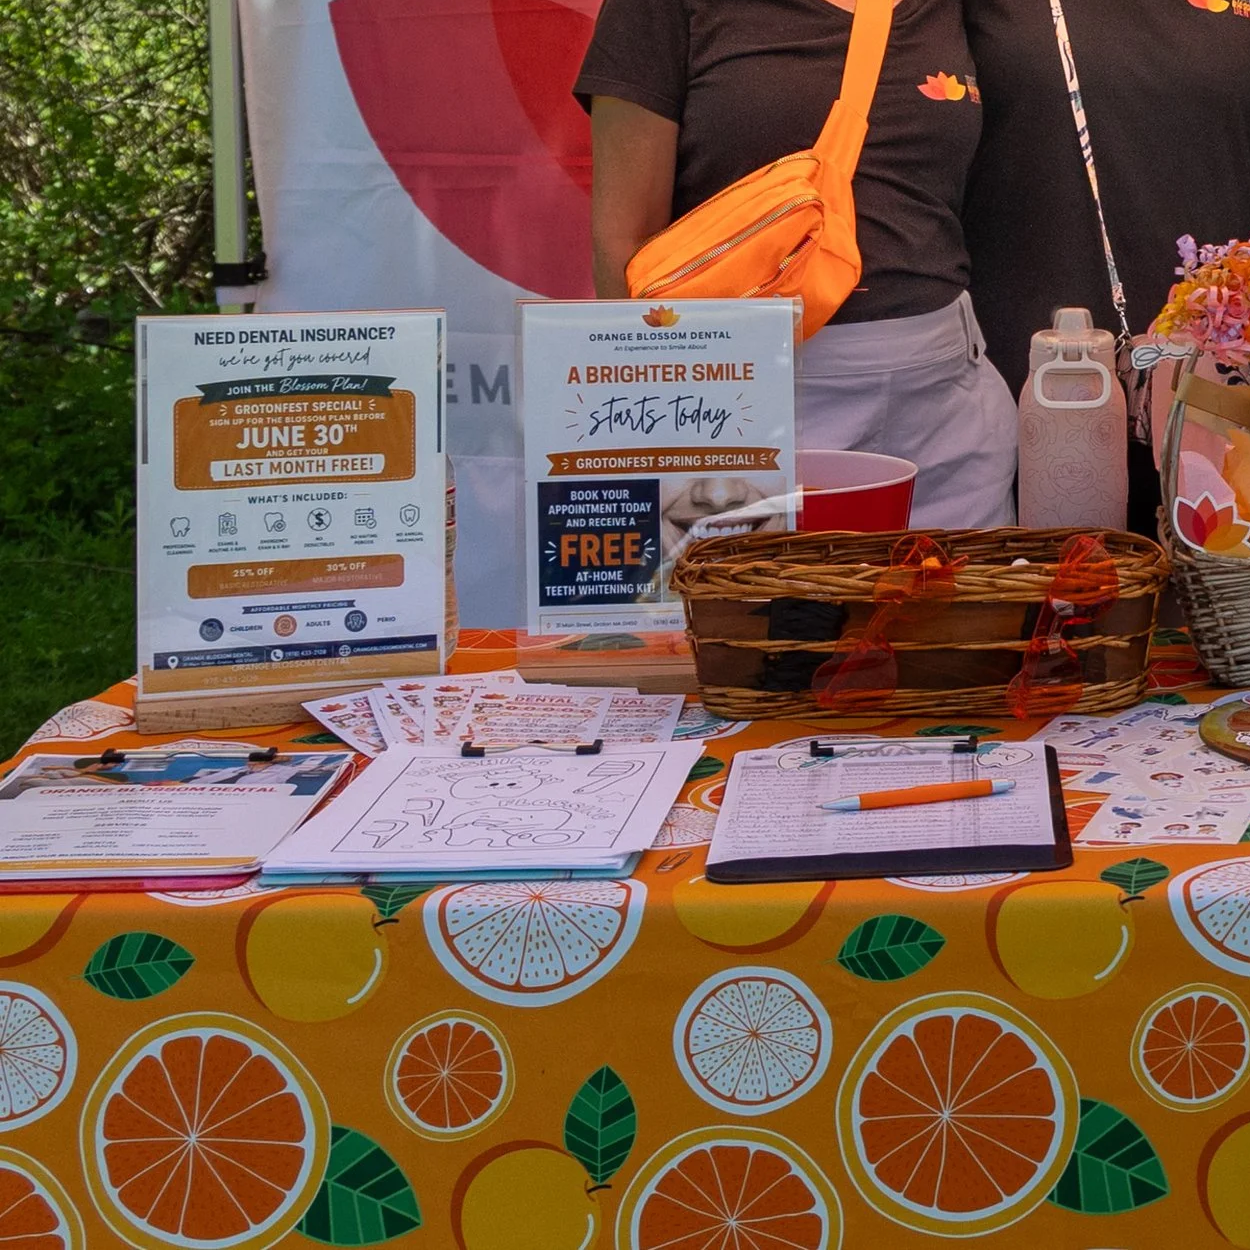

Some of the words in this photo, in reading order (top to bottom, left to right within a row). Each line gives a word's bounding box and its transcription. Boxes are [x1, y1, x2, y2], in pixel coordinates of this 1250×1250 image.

[194, 332, 235, 345] NEED
[239, 330, 297, 344] DENTAL
[300, 327, 396, 342] INSURANCE?
[589, 333, 633, 341] ORANGE
[636, 332, 687, 340] BLOSSOM
[690, 331, 731, 340] DENTAL
[219, 348, 260, 367] we've
[263, 348, 292, 371] got
[288, 353, 316, 371] you
[318, 346, 371, 366] covered
[567, 367, 581, 384] A
[586, 364, 687, 383] BRIGHTER
[692, 362, 754, 382] SMILE
[226, 384, 251, 396] JOIN
[254, 383, 275, 392] THE
[279, 377, 329, 394] Blossom
[331, 377, 368, 392] Plan!
[234, 402, 310, 415] GROTONFEST
[312, 400, 362, 412] SPECIAL!
[209, 418, 231, 427] SIGN
[232, 417, 245, 426] UP
[247, 417, 263, 425] FOR
[266, 416, 282, 424] THE
[284, 414, 326, 423] BLOSSOM
[353, 412, 385, 421] BEFORE
[589, 396, 667, 436] starts
[666, 395, 732, 439] today
[236, 425, 306, 450] JUNE
[305, 448, 328, 456] YOUR
[224, 462, 264, 477] LAST
[269, 459, 326, 474] MONTH
[331, 457, 374, 472] FREE!
[576, 456, 655, 469] GROTONFEST
[658, 455, 702, 467] SPRING
[704, 453, 755, 466] SPECIAL!
[247, 494, 289, 504] WHAT'S
[292, 491, 348, 503] INCLUDED:
[570, 490, 599, 501] BOOK
[602, 489, 630, 500] YOUR
[548, 503, 618, 515] APPOINTMENT
[620, 502, 652, 512] TODAY
[566, 518, 586, 528] AND
[588, 517, 627, 527] RECEIVE
[628, 517, 636, 526] A
[560, 532, 641, 567] FREE
[233, 569, 255, 578] 25%
[257, 567, 275, 576] OFF
[326, 563, 347, 572] 30%
[349, 561, 366, 571] OFF
[575, 570, 624, 582] AT-HOME
[545, 585, 576, 597] TEETH
[578, 583, 634, 595] WHITENING
[636, 582, 656, 594] KIT!
